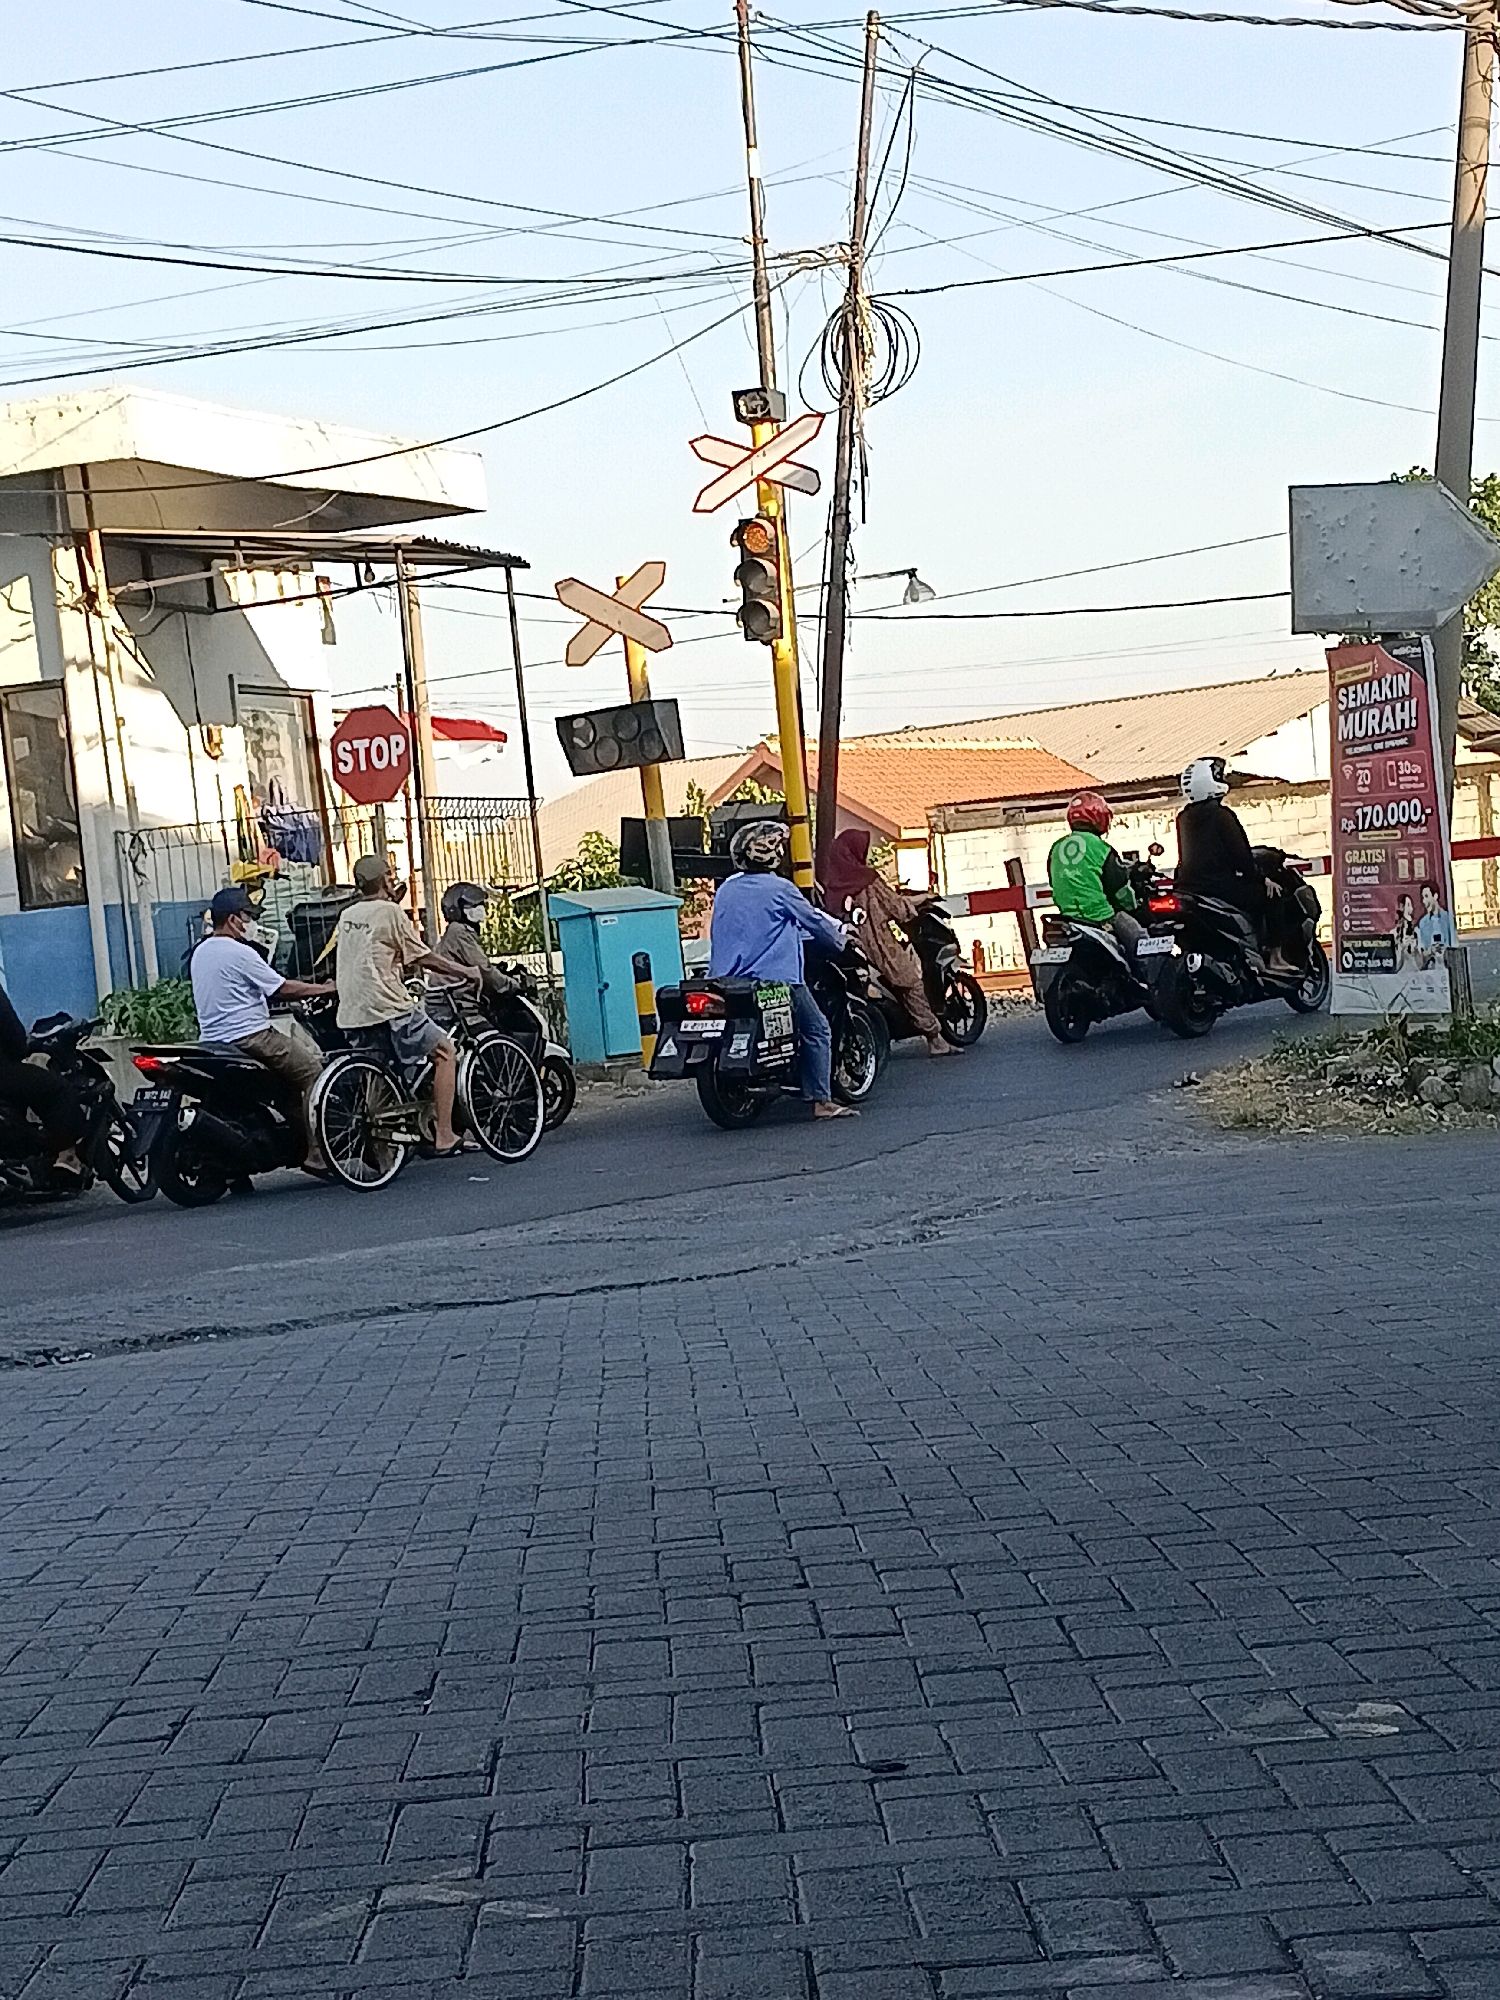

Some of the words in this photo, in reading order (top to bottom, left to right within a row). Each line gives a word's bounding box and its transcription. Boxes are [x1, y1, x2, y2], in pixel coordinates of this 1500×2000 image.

[1337, 671, 1411, 711] SEMAKIN
[1338, 698, 1418, 741] MURAH!
[337, 734, 406, 774] STOP
[1345, 849, 1386, 864] GRATIS!
